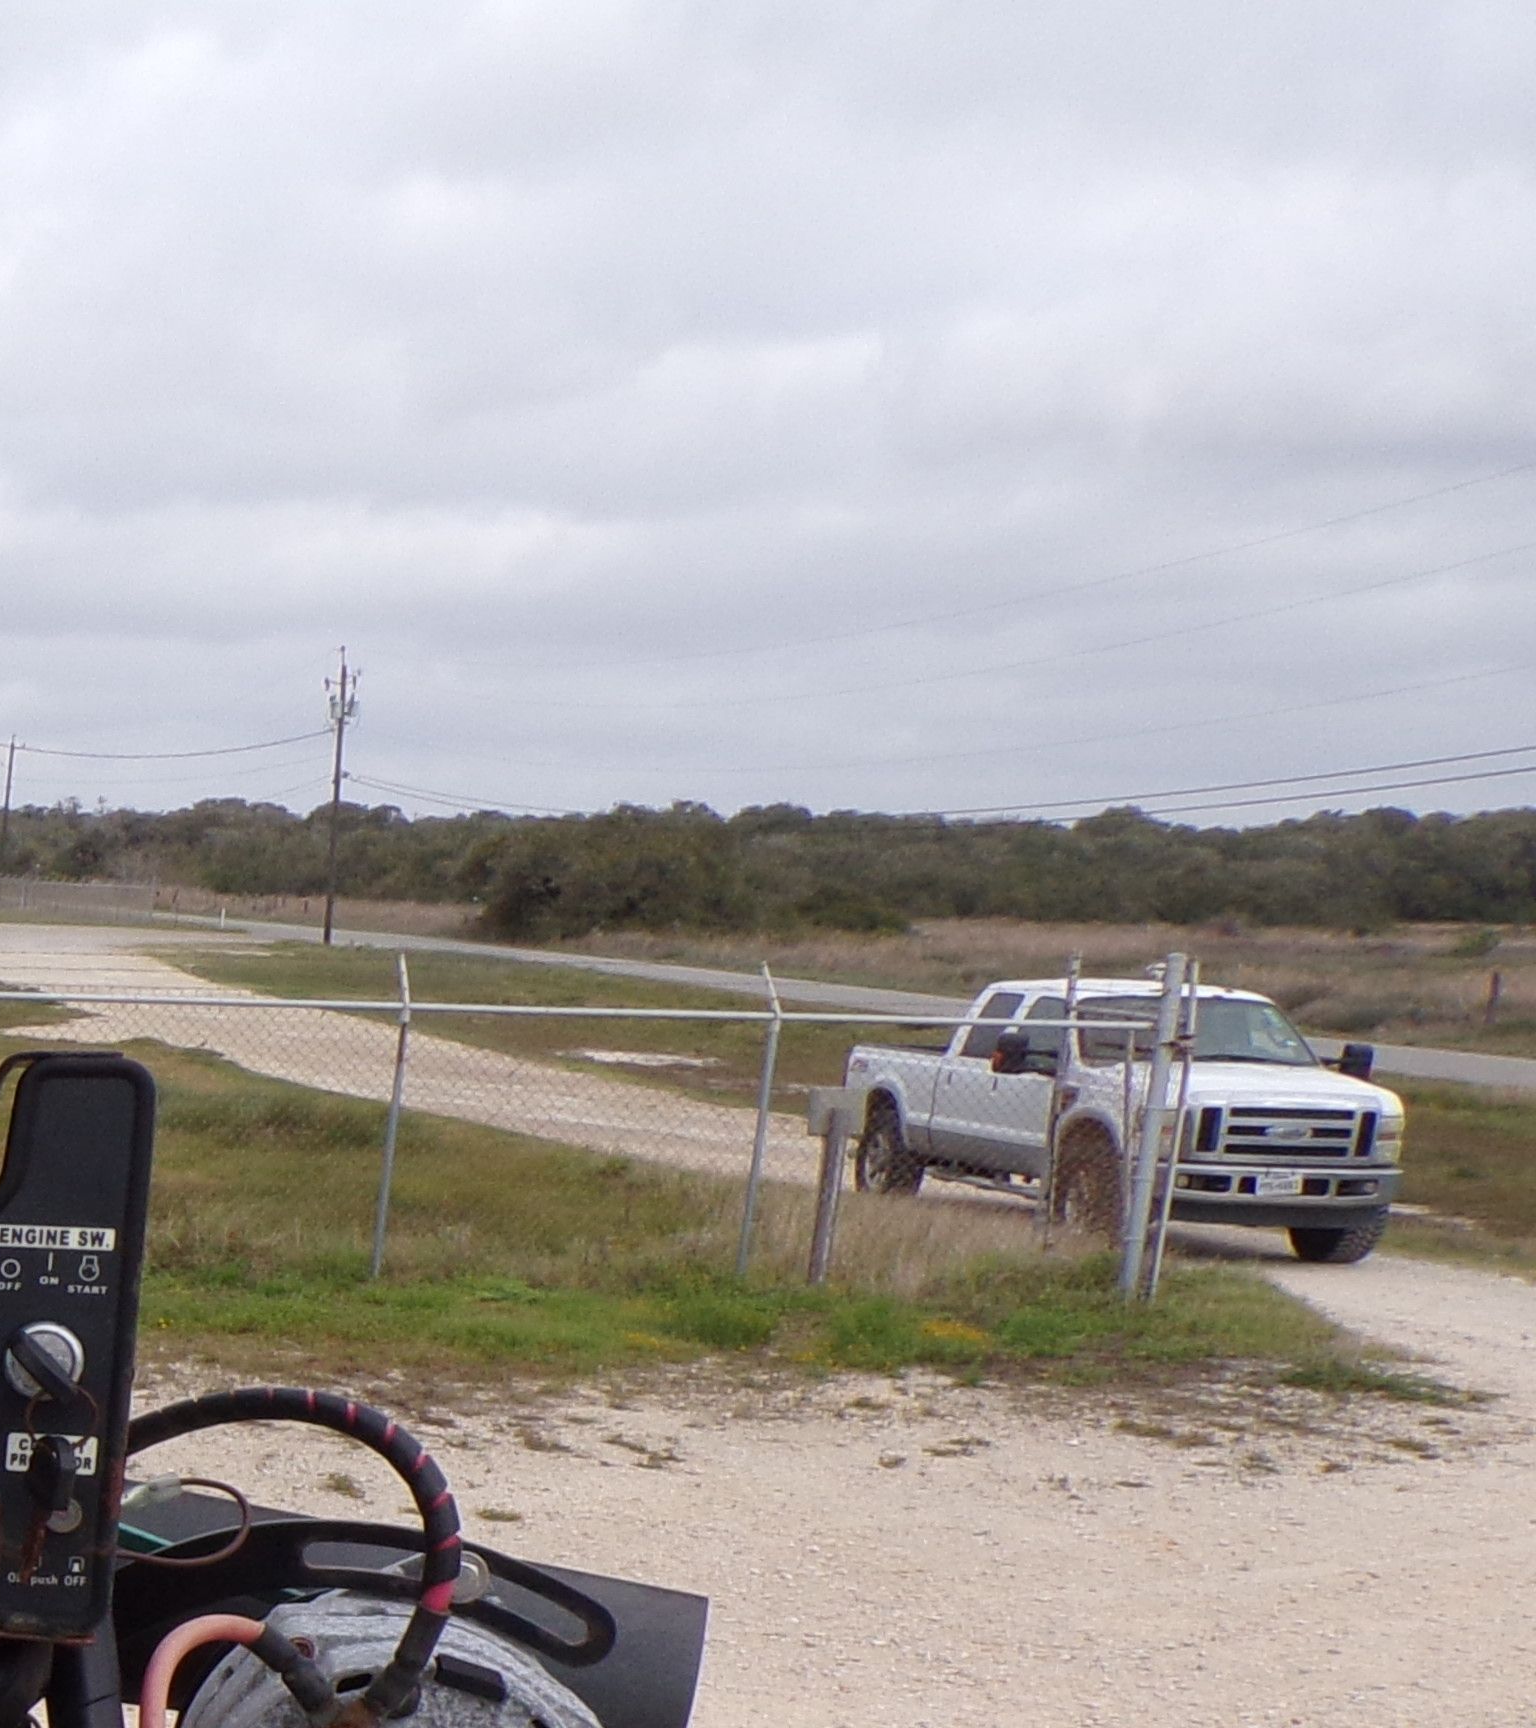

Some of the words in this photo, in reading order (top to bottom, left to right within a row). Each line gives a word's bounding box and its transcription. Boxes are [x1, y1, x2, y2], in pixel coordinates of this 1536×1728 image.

[0, 1227, 71, 1246] ENGINE
[77, 1230, 110, 1249] SW.
[39, 1275, 60, 1285] ON
[67, 1284, 108, 1295] START
[30, 1573, 58, 1587] push
[63, 1575, 88, 1587] OFF
